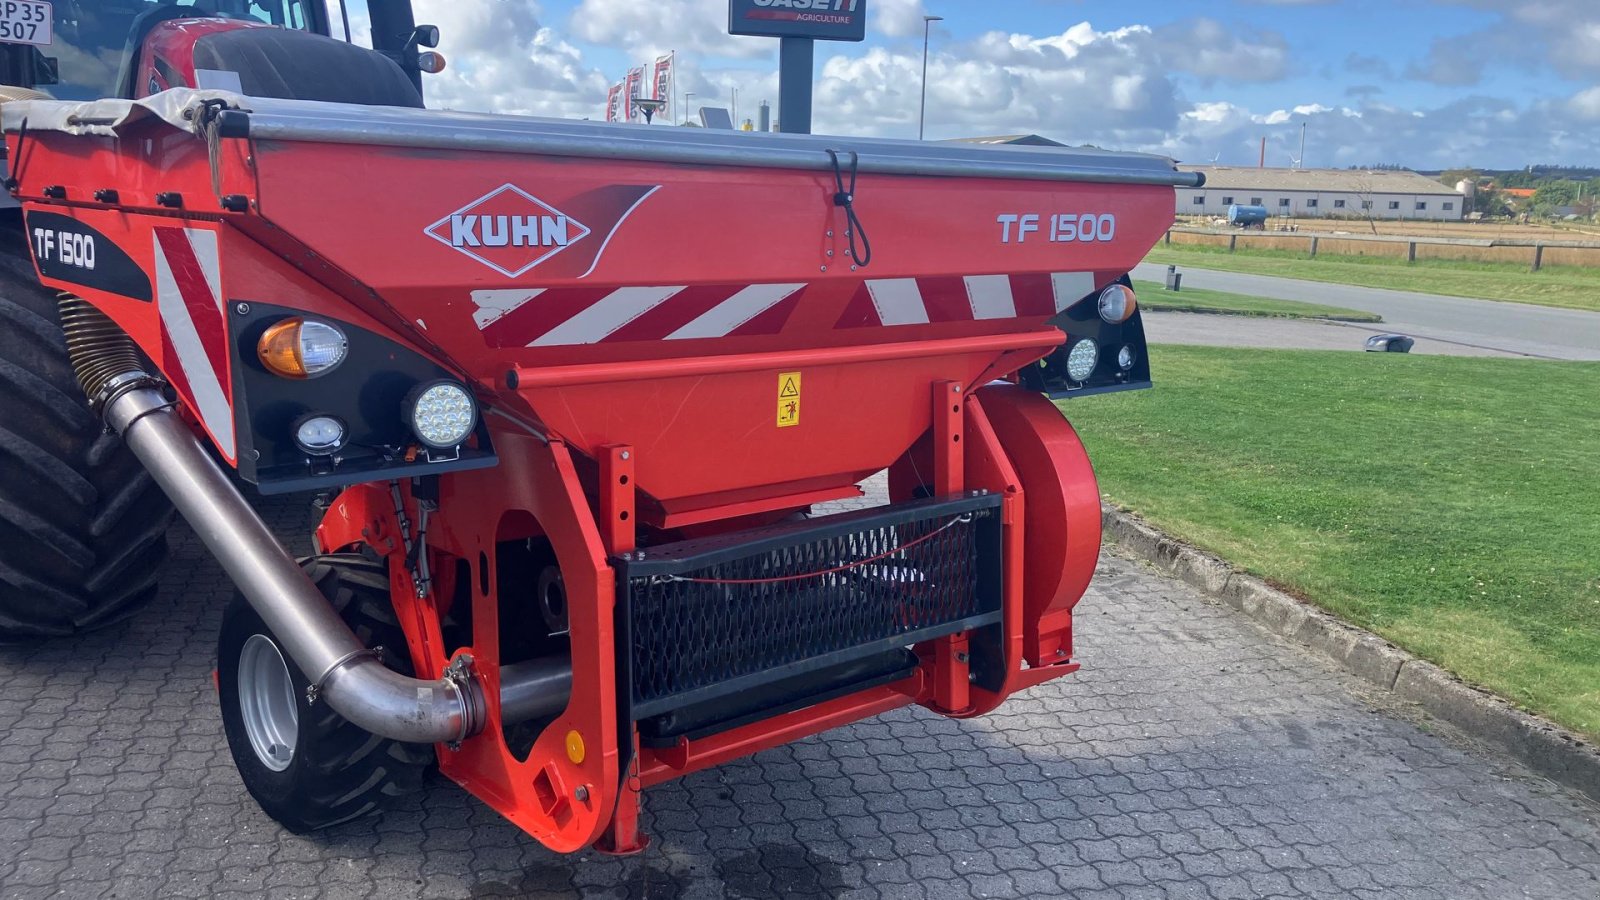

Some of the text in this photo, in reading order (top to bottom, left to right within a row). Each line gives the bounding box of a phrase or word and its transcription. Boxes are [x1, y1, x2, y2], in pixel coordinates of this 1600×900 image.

[0, 1, 45, 22] P35
[796, 13, 850, 24] AGRICULTURE
[0, 20, 37, 40] 507
[450, 214, 568, 247] KUHN
[996, 213, 1116, 243] TF 1500
[34, 227, 95, 270] TF 1500
